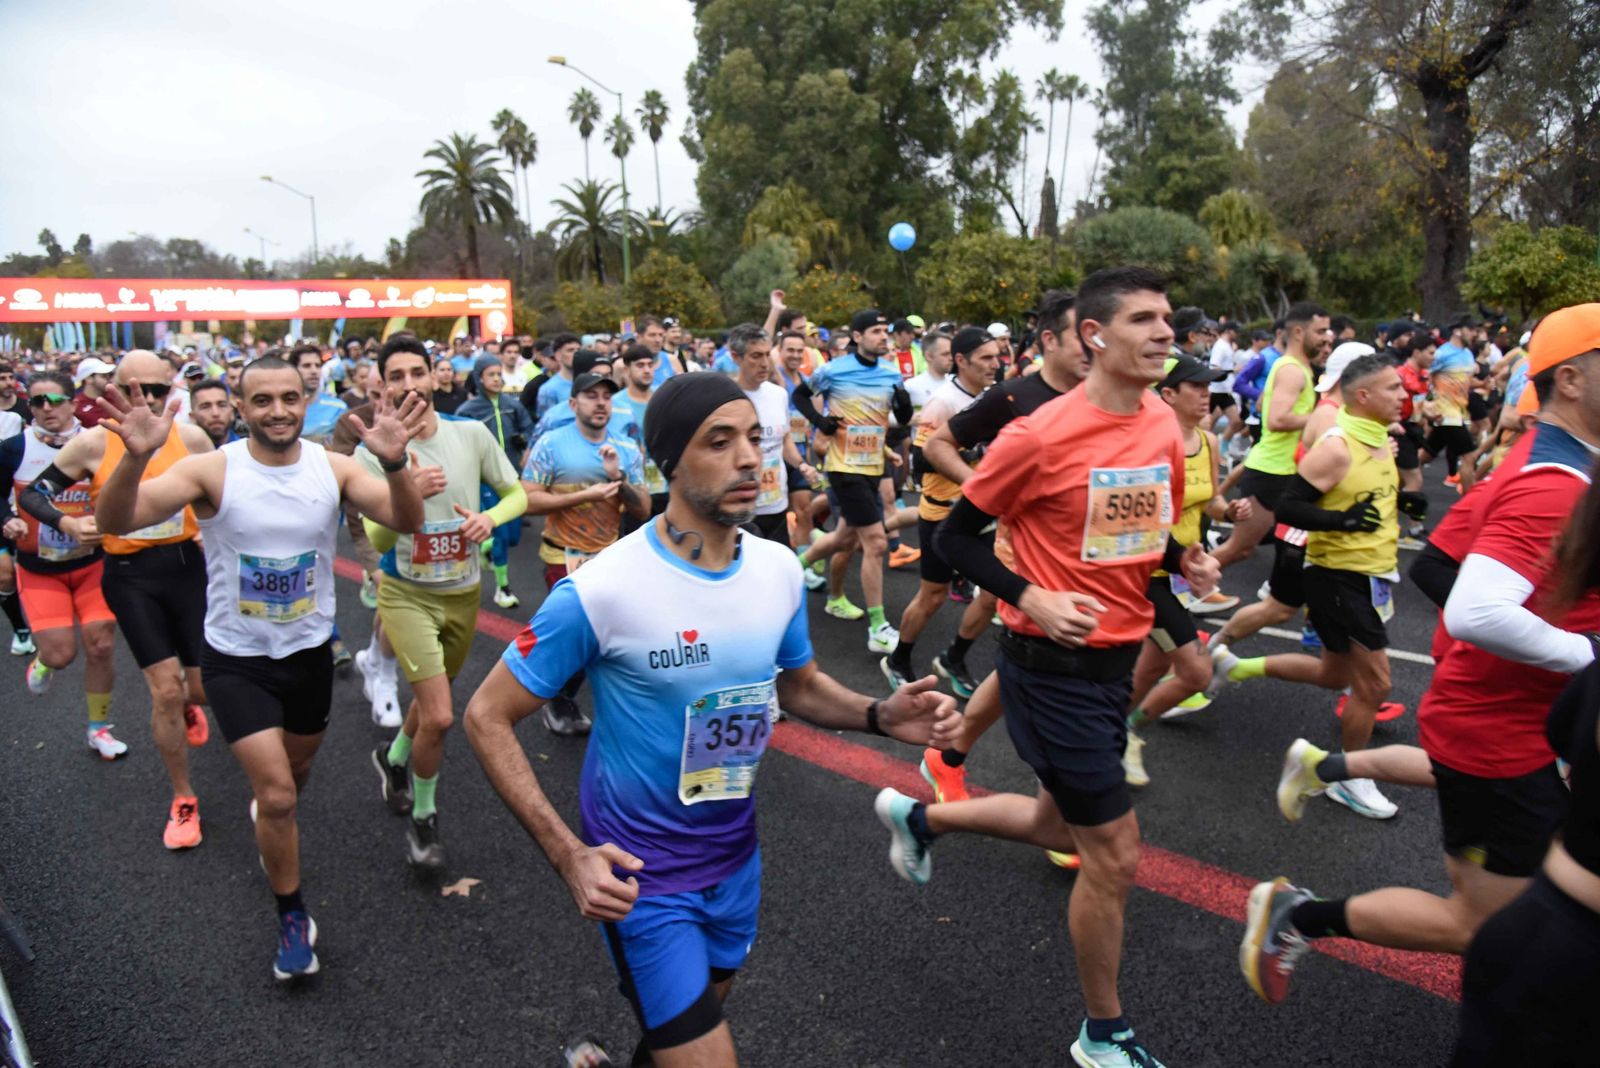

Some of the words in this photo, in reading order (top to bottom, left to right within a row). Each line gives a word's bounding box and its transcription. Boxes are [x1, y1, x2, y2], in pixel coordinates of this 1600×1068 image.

[1106, 491, 1157, 520] 5969
[429, 535, 461, 556] 385
[252, 571, 300, 594] 3887
[648, 631, 710, 669] COURIR
